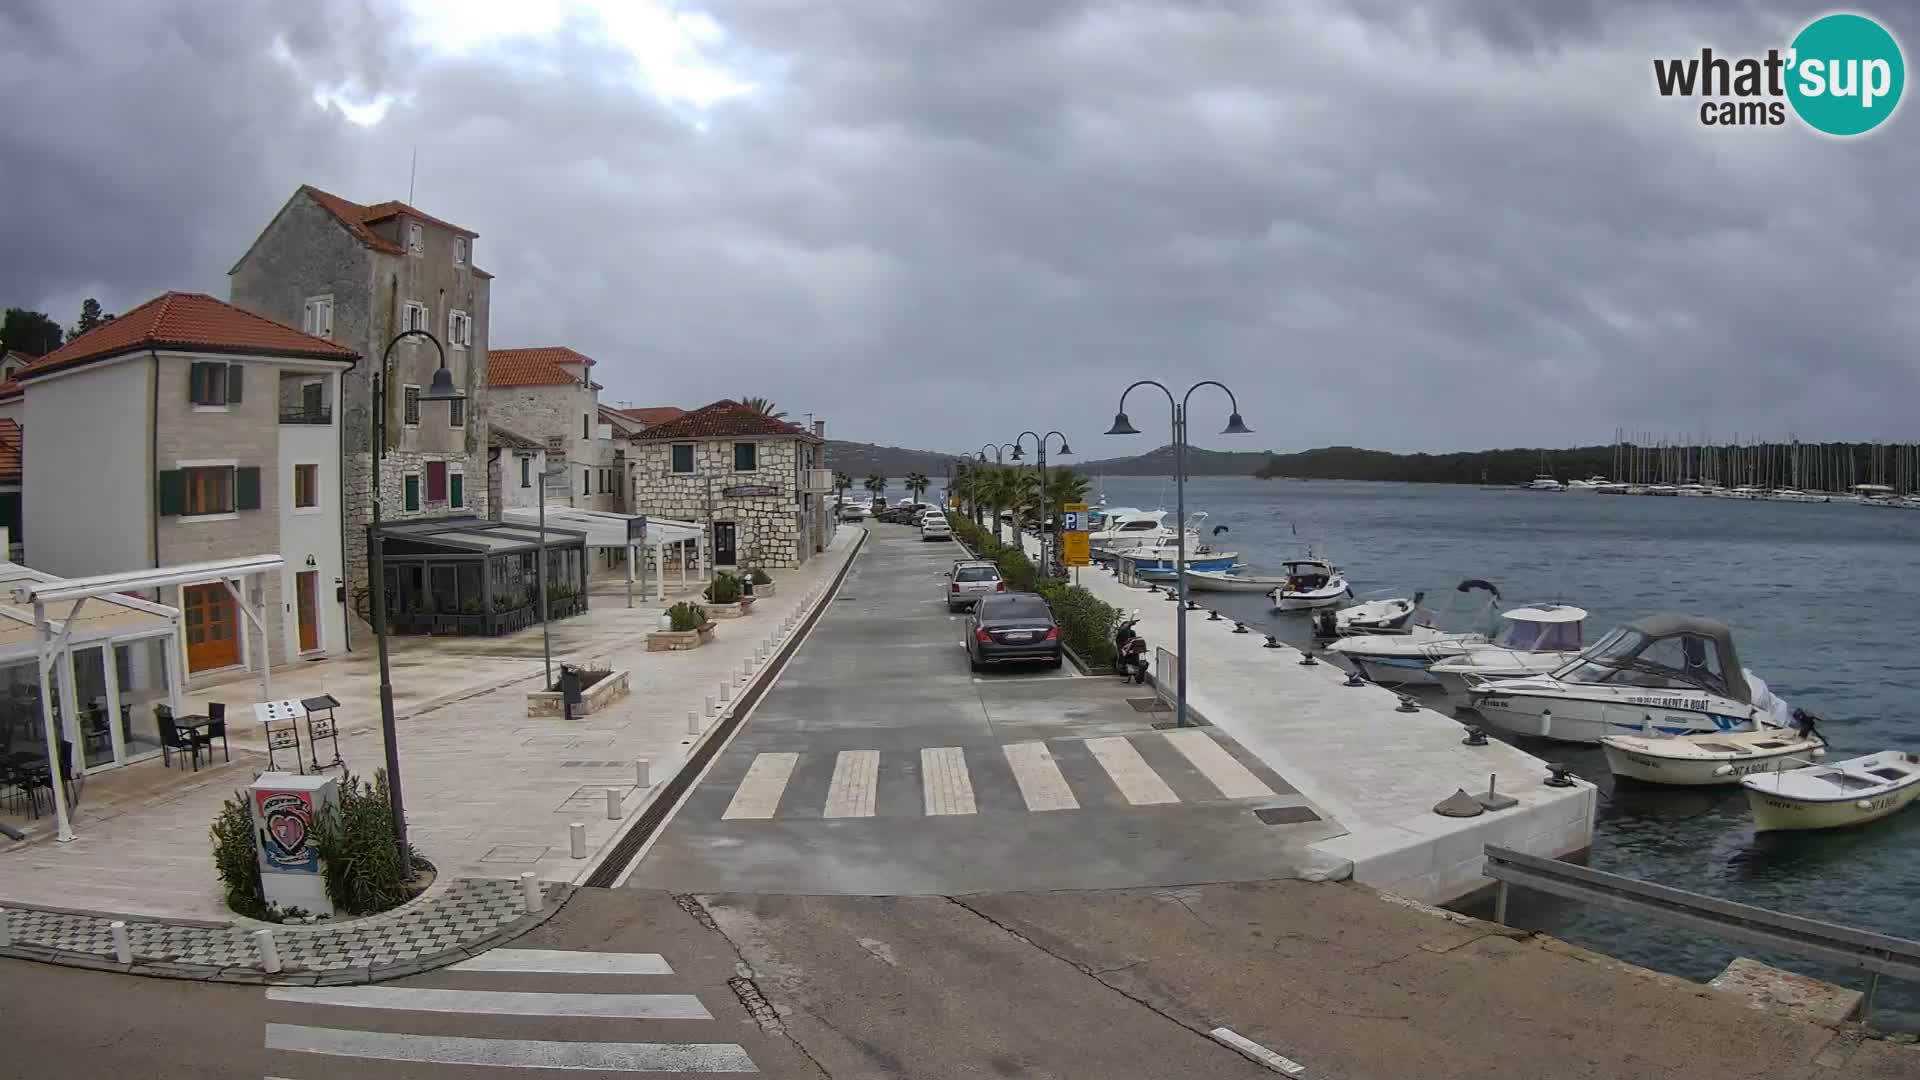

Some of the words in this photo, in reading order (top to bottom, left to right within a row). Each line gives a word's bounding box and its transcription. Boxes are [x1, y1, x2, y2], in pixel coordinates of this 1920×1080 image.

[1065, 513, 1076, 529] P
[1663, 698, 1683, 708] RENT
[1690, 700, 1709, 711] BOAT
